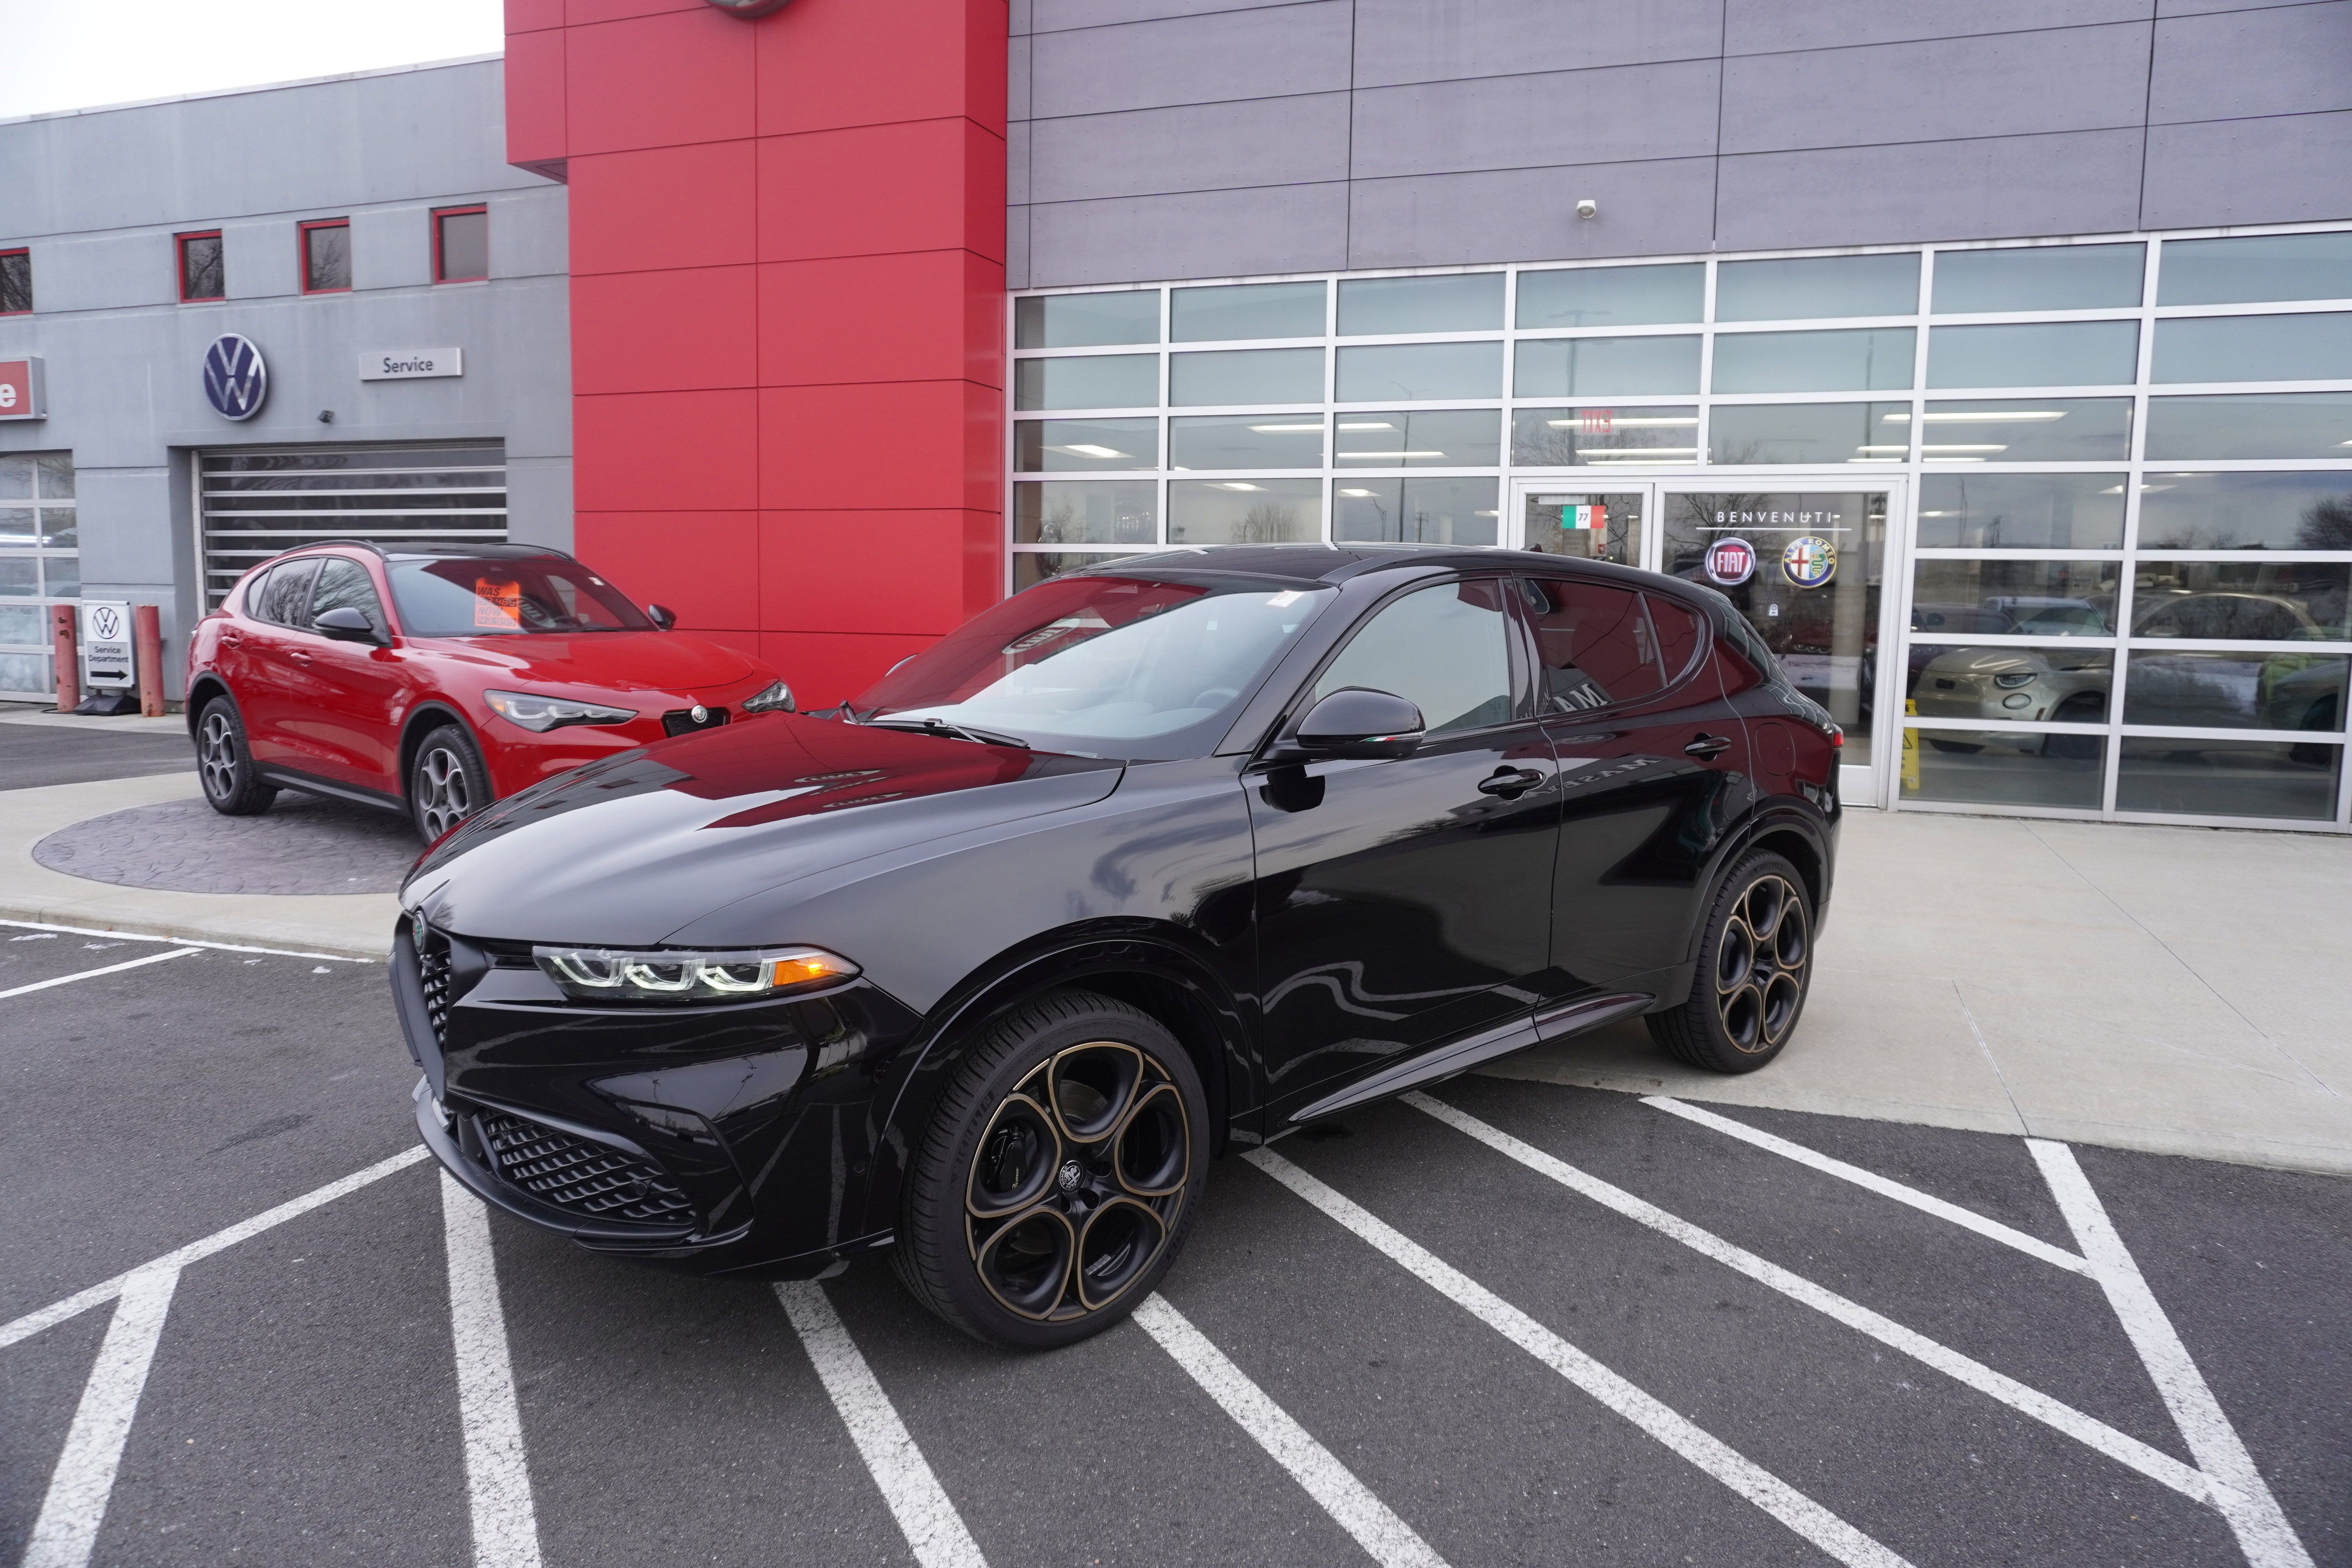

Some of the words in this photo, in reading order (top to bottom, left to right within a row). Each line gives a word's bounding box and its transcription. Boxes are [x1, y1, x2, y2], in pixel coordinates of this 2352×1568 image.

[383, 356, 433, 373] Service
[1578, 513, 1589, 521] 77
[1717, 511, 1831, 523] BENVENUTI
[1784, 540, 1803, 564] ALFA
[1808, 538, 1835, 564] ROMEO
[1717, 551, 1746, 572] FIAT
[477, 586, 500, 596] WAS
[478, 606, 503, 616] NOW
[88, 655, 129, 663] Department
